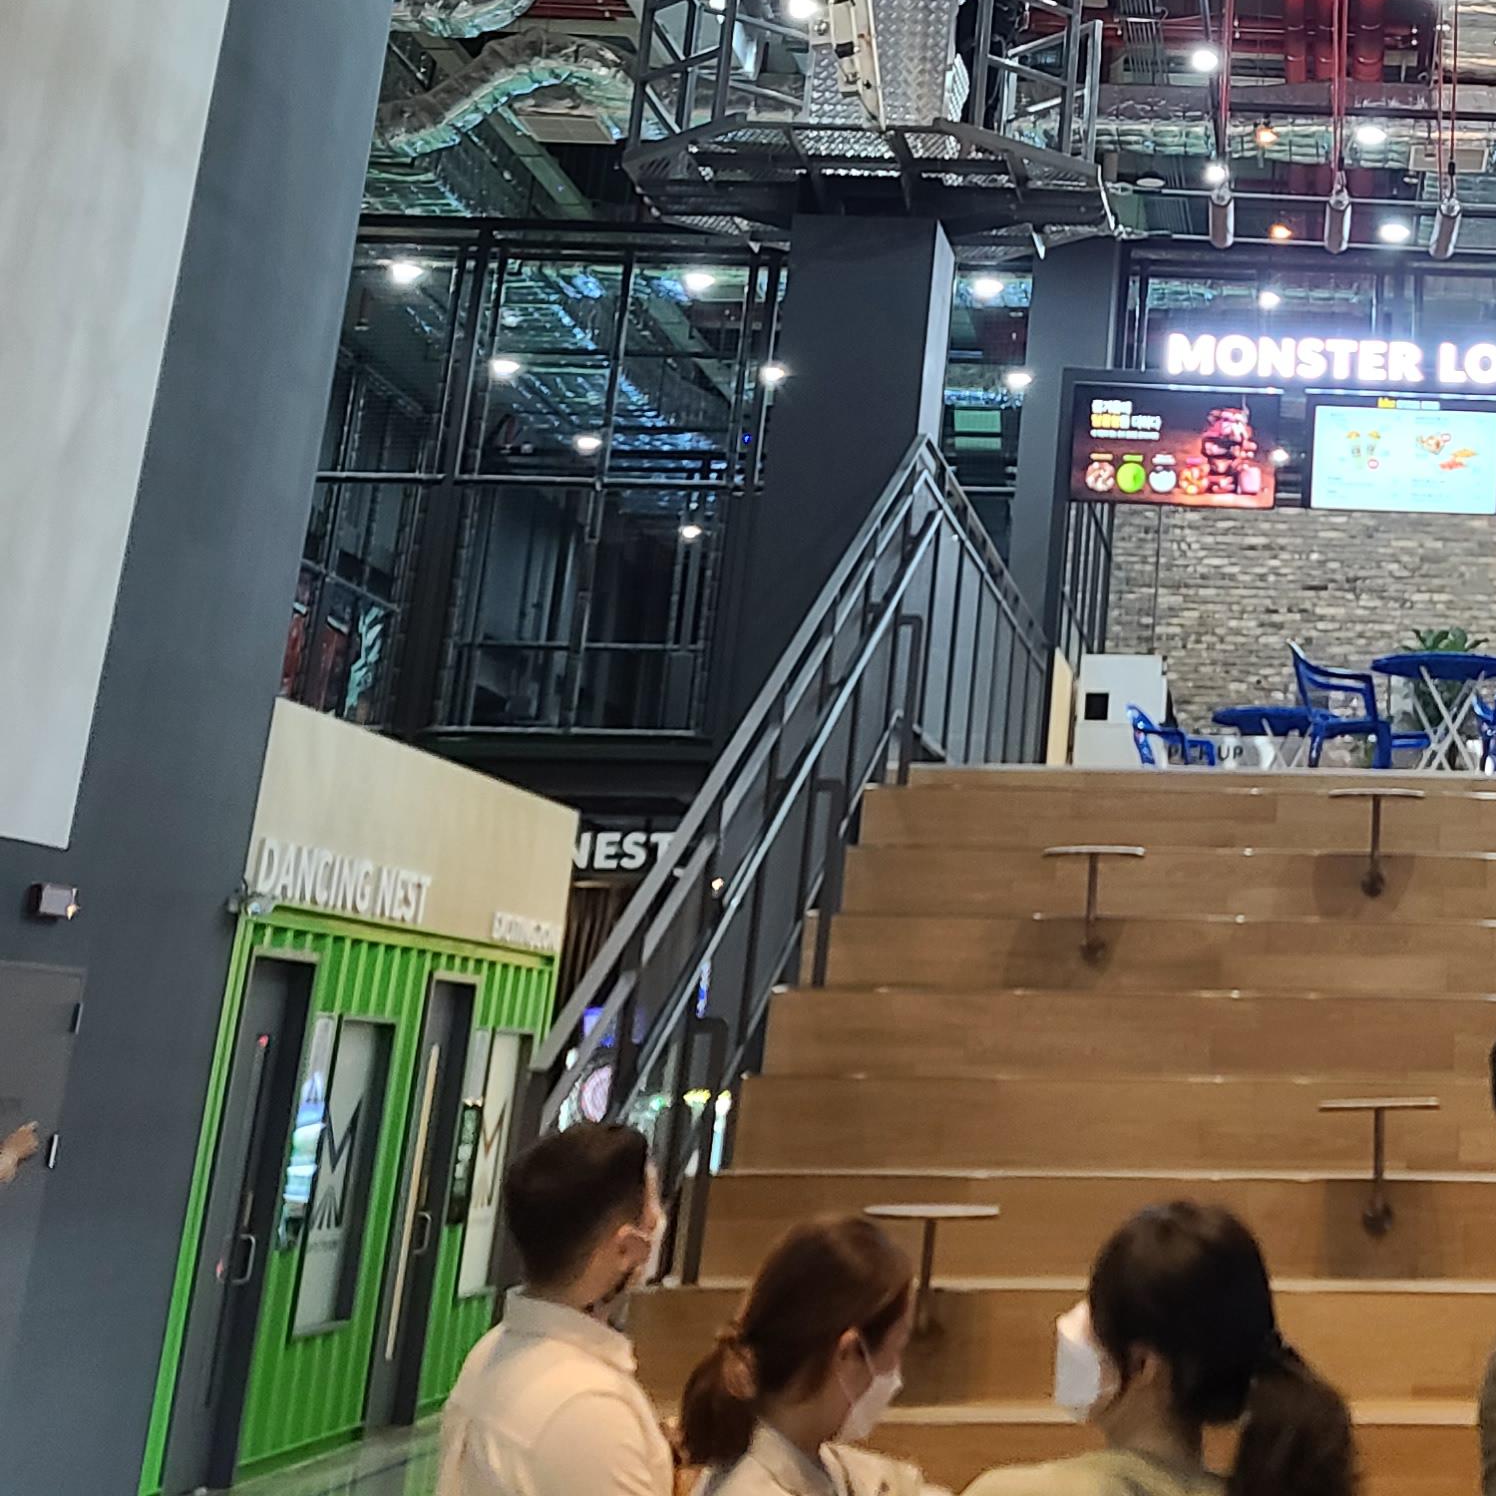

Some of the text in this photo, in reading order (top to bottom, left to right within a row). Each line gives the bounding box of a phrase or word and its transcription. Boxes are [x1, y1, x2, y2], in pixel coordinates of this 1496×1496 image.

[1166, 332, 1424, 383] MONSTER
[1218, 746, 1243, 761] UP
[256, 838, 432, 925] DANCING NEST
